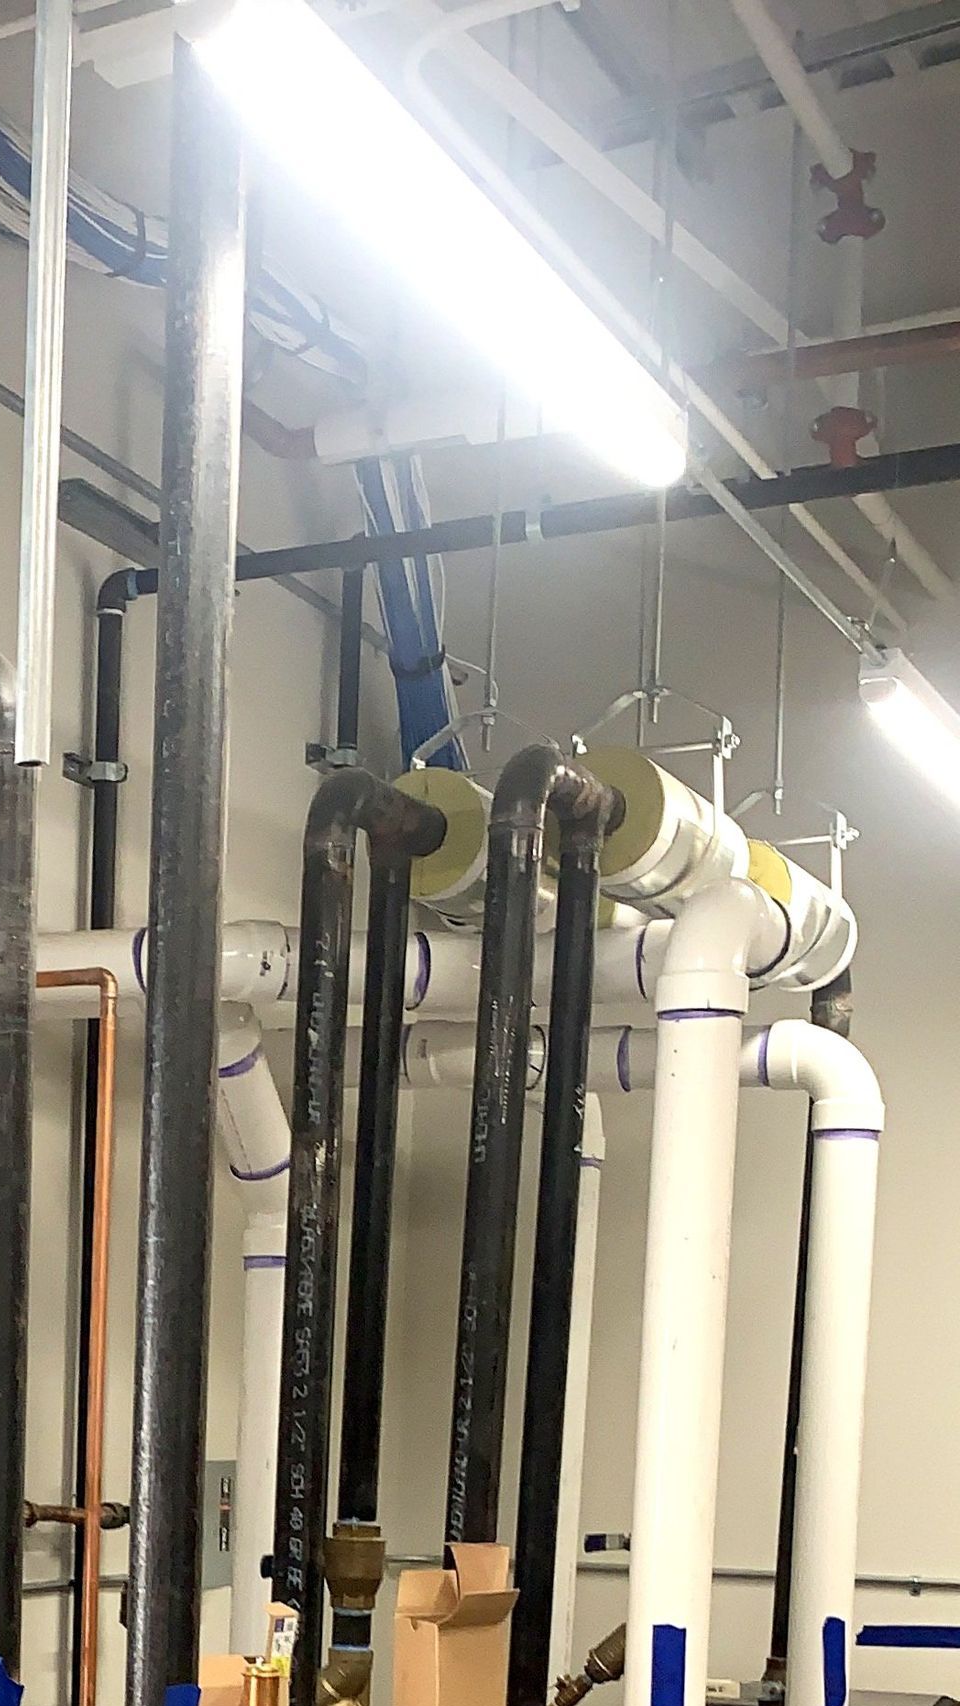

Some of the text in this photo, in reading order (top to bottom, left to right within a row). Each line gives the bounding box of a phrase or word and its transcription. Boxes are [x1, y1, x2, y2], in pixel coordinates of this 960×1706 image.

[292, 1383, 309, 1399] 2
[290, 1462, 306, 1499] SCH
[289, 1506, 304, 1530] 40
